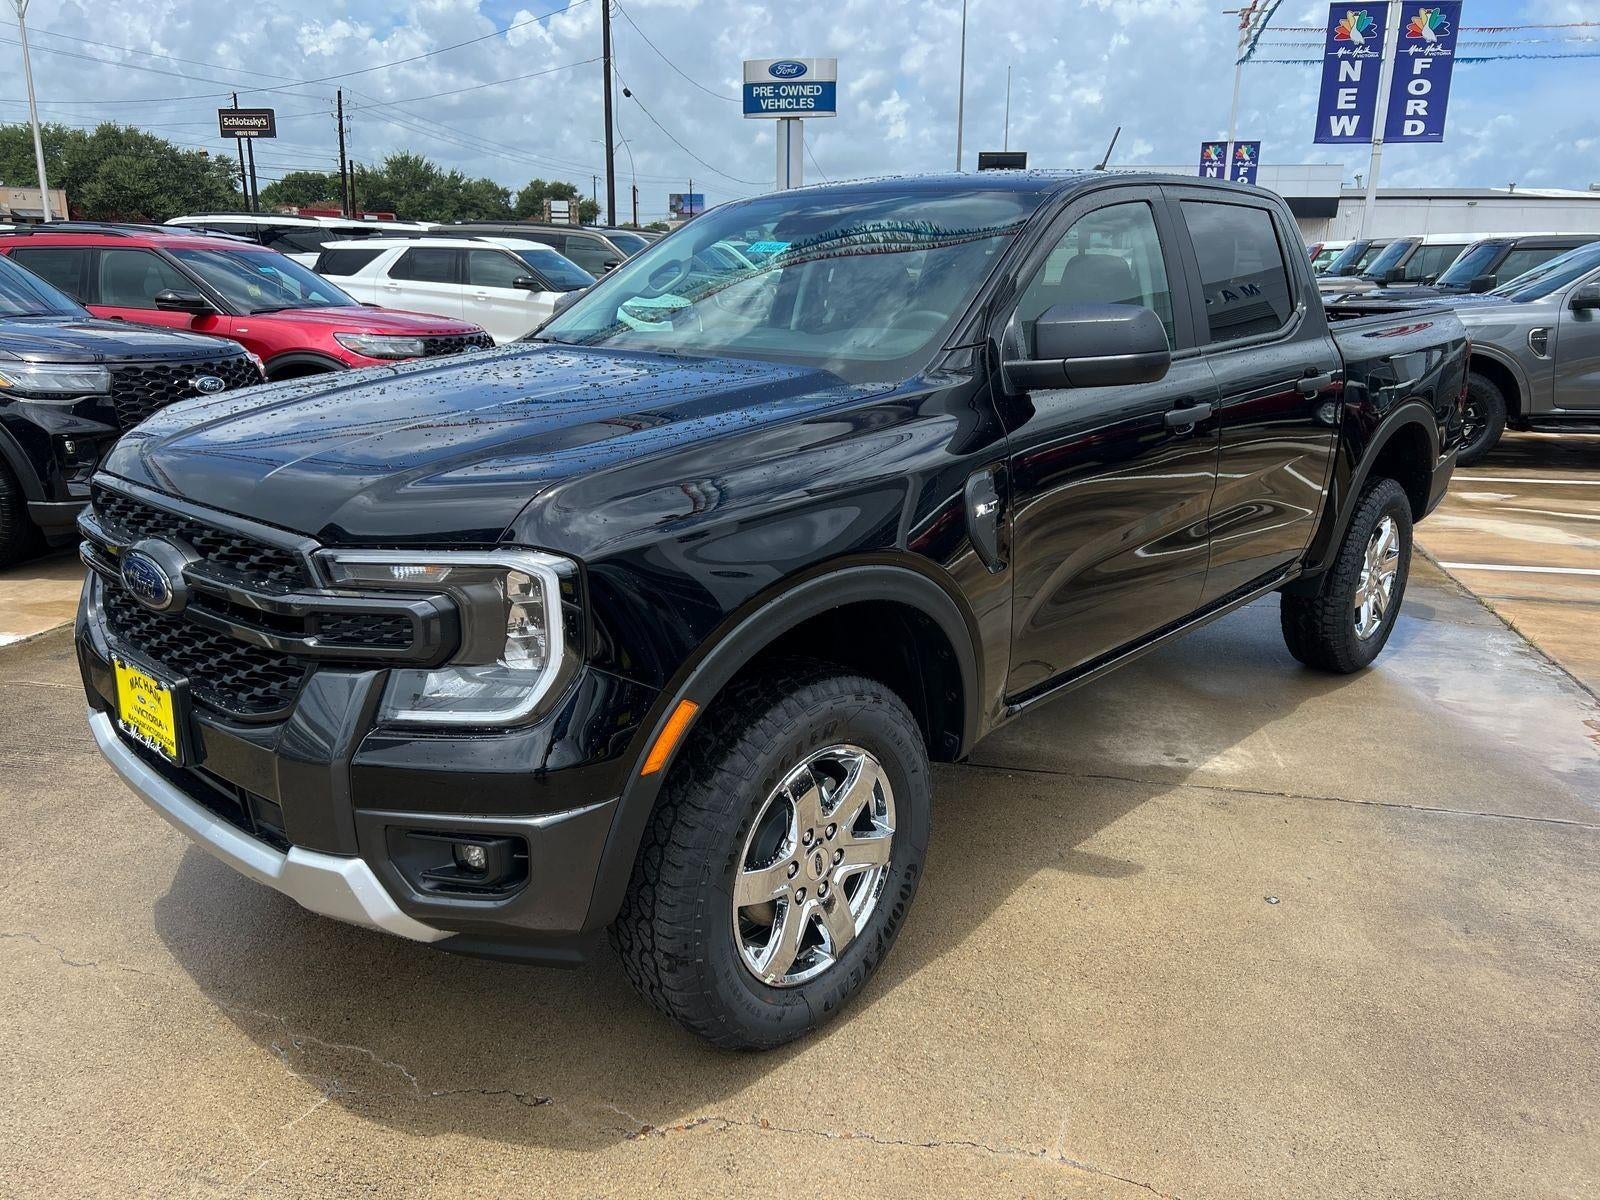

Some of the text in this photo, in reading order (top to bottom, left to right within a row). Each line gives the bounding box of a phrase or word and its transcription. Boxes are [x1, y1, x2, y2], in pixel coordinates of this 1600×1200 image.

[775, 63, 798, 75] Ford
[752, 84, 823, 98] PRE-OWNED
[1402, 58, 1433, 136] FORD
[760, 98, 815, 110] VEHICLES
[1329, 60, 1362, 137] NEW
[223, 116, 268, 127] Schlotzsky's
